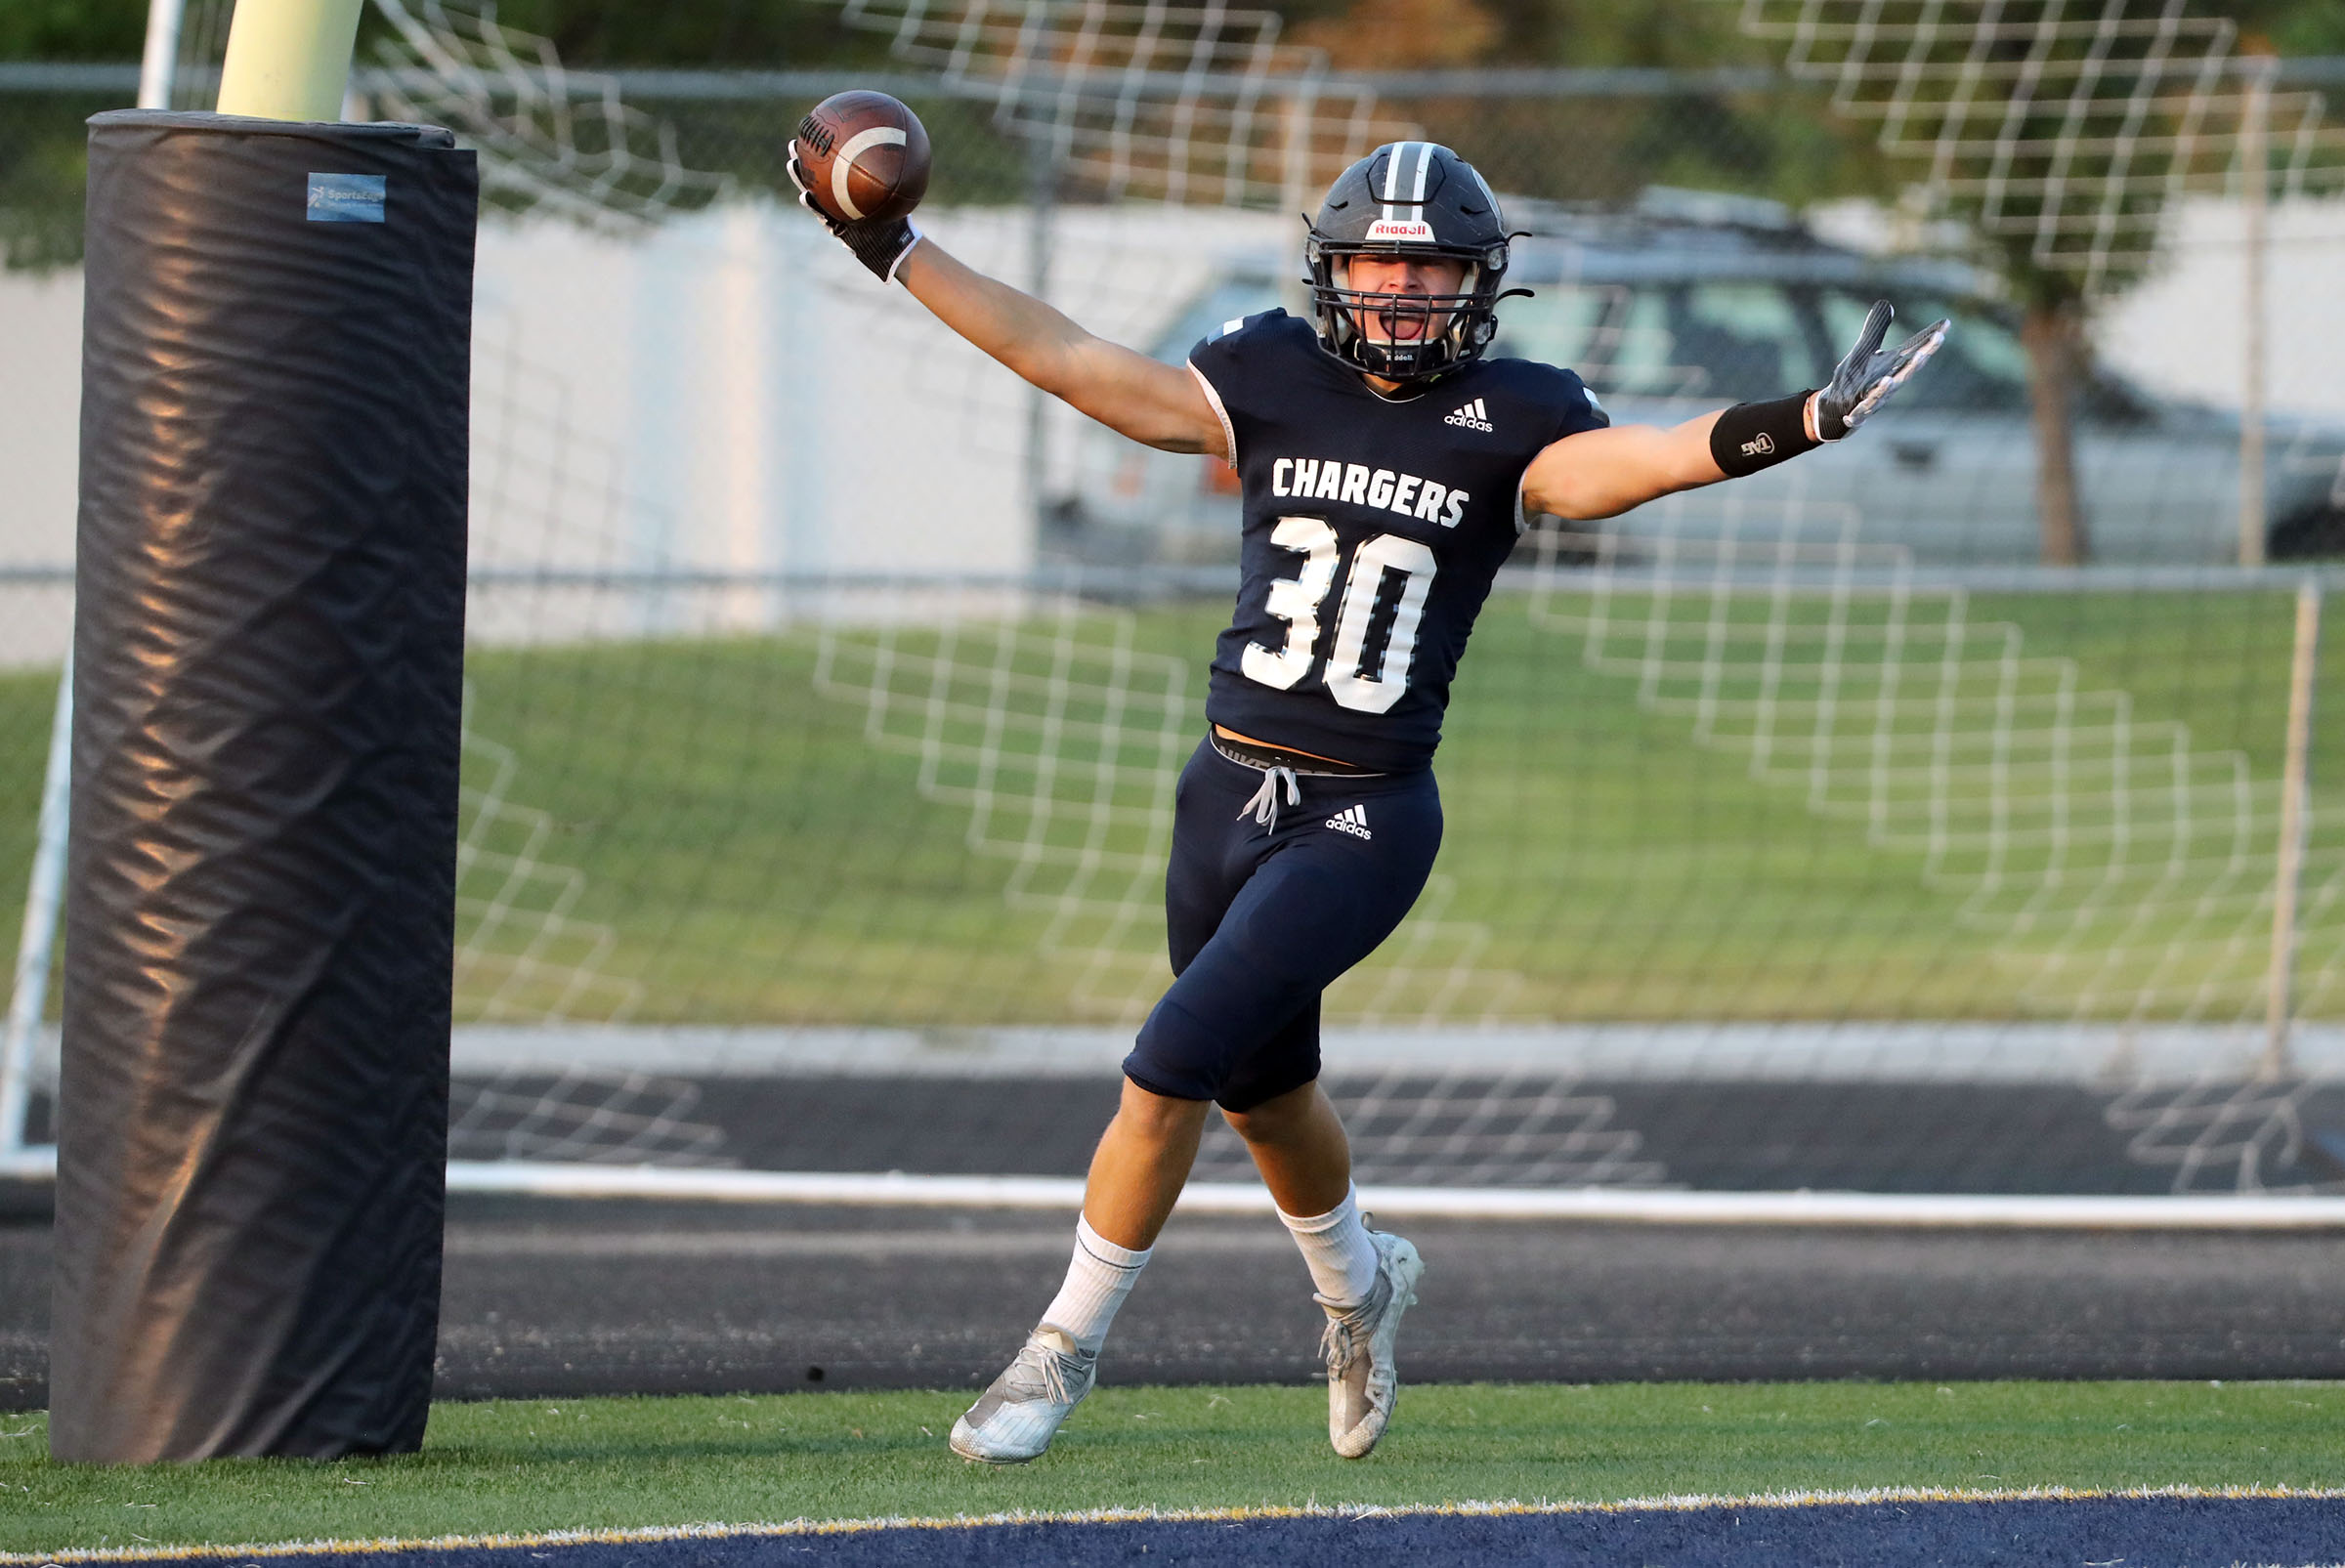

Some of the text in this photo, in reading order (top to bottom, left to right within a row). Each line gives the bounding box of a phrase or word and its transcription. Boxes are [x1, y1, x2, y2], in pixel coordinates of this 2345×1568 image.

[1444, 414, 1493, 432] adidas
[1272, 457, 1470, 529] CHARGERS
[1241, 516, 1438, 714] 30
[1325, 819, 1372, 840] adidas
